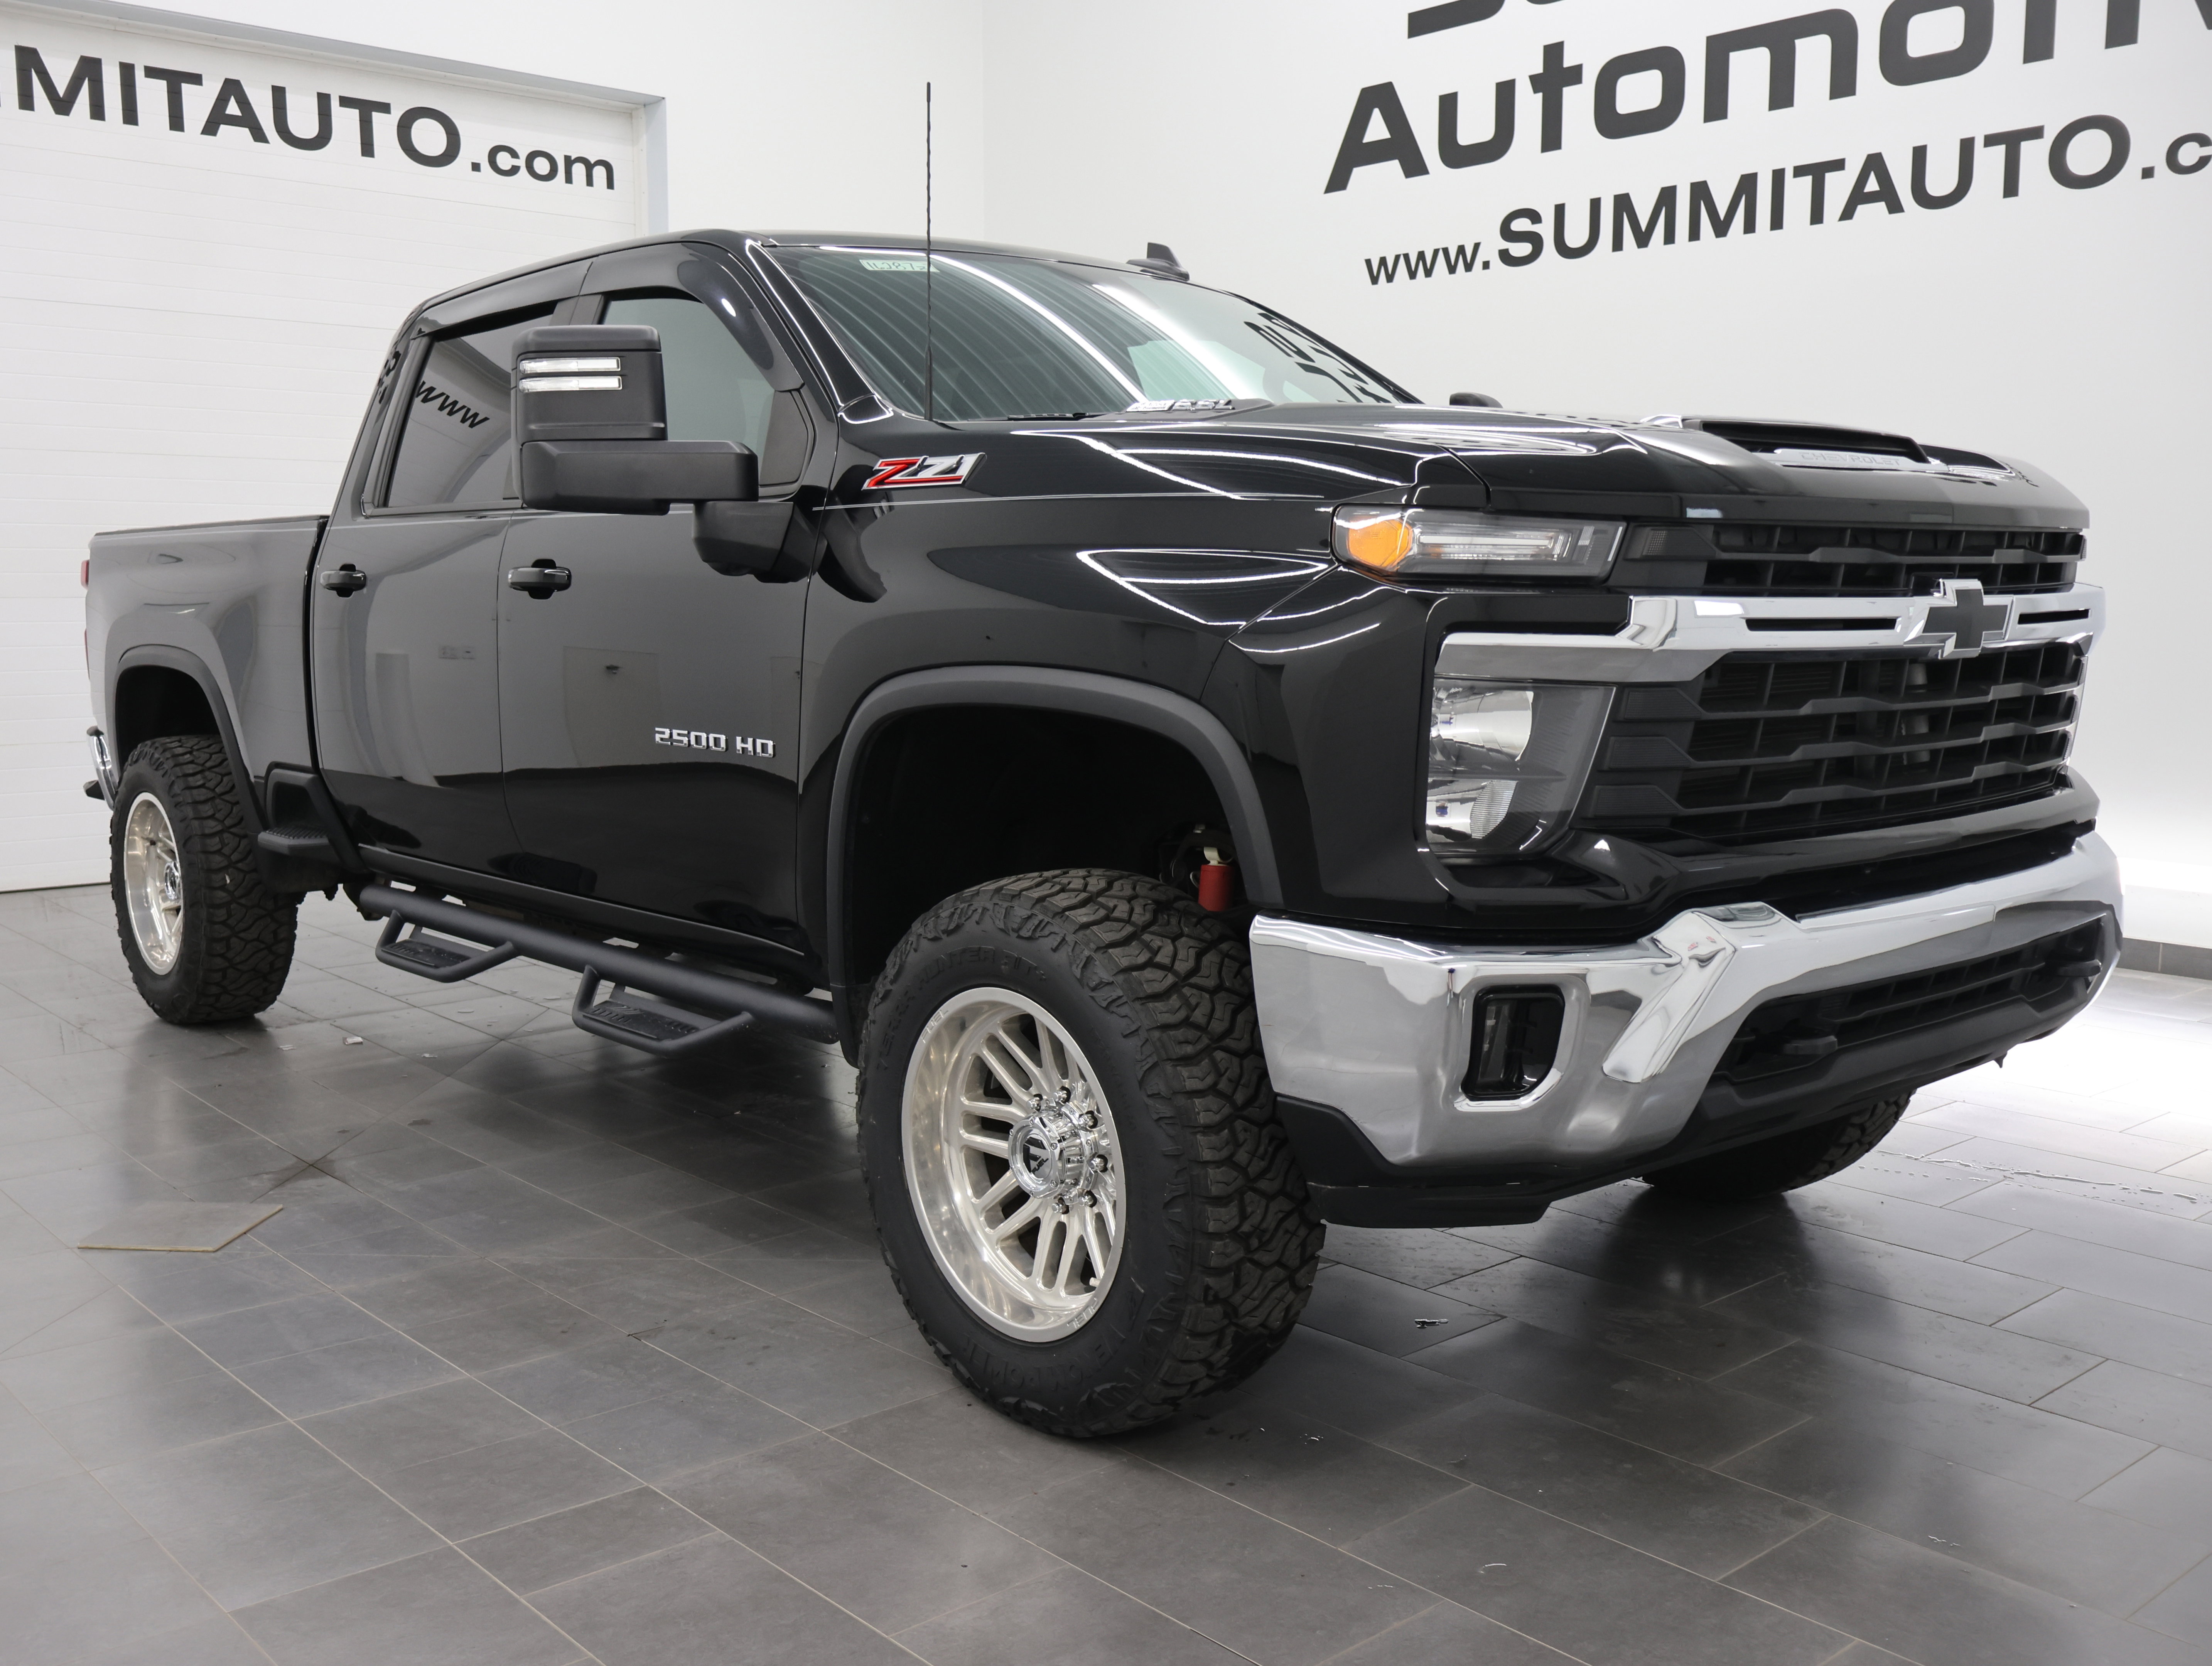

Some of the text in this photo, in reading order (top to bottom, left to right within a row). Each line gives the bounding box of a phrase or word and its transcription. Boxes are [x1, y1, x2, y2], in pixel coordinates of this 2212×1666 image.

[1324, 0, 2212, 194] Automo
[0, 45, 614, 190] MITAUTO.com
[861, 452, 987, 491] Z71
[1799, 452, 1900, 466] CHEVROLET
[655, 727, 775, 758] 2500 HD
[917, 945, 995, 991] HUNTER
[920, 1009, 949, 1044] FUEL
[1031, 1157, 1049, 1175] FUEL
[1066, 1295, 1099, 1330] FUEL
